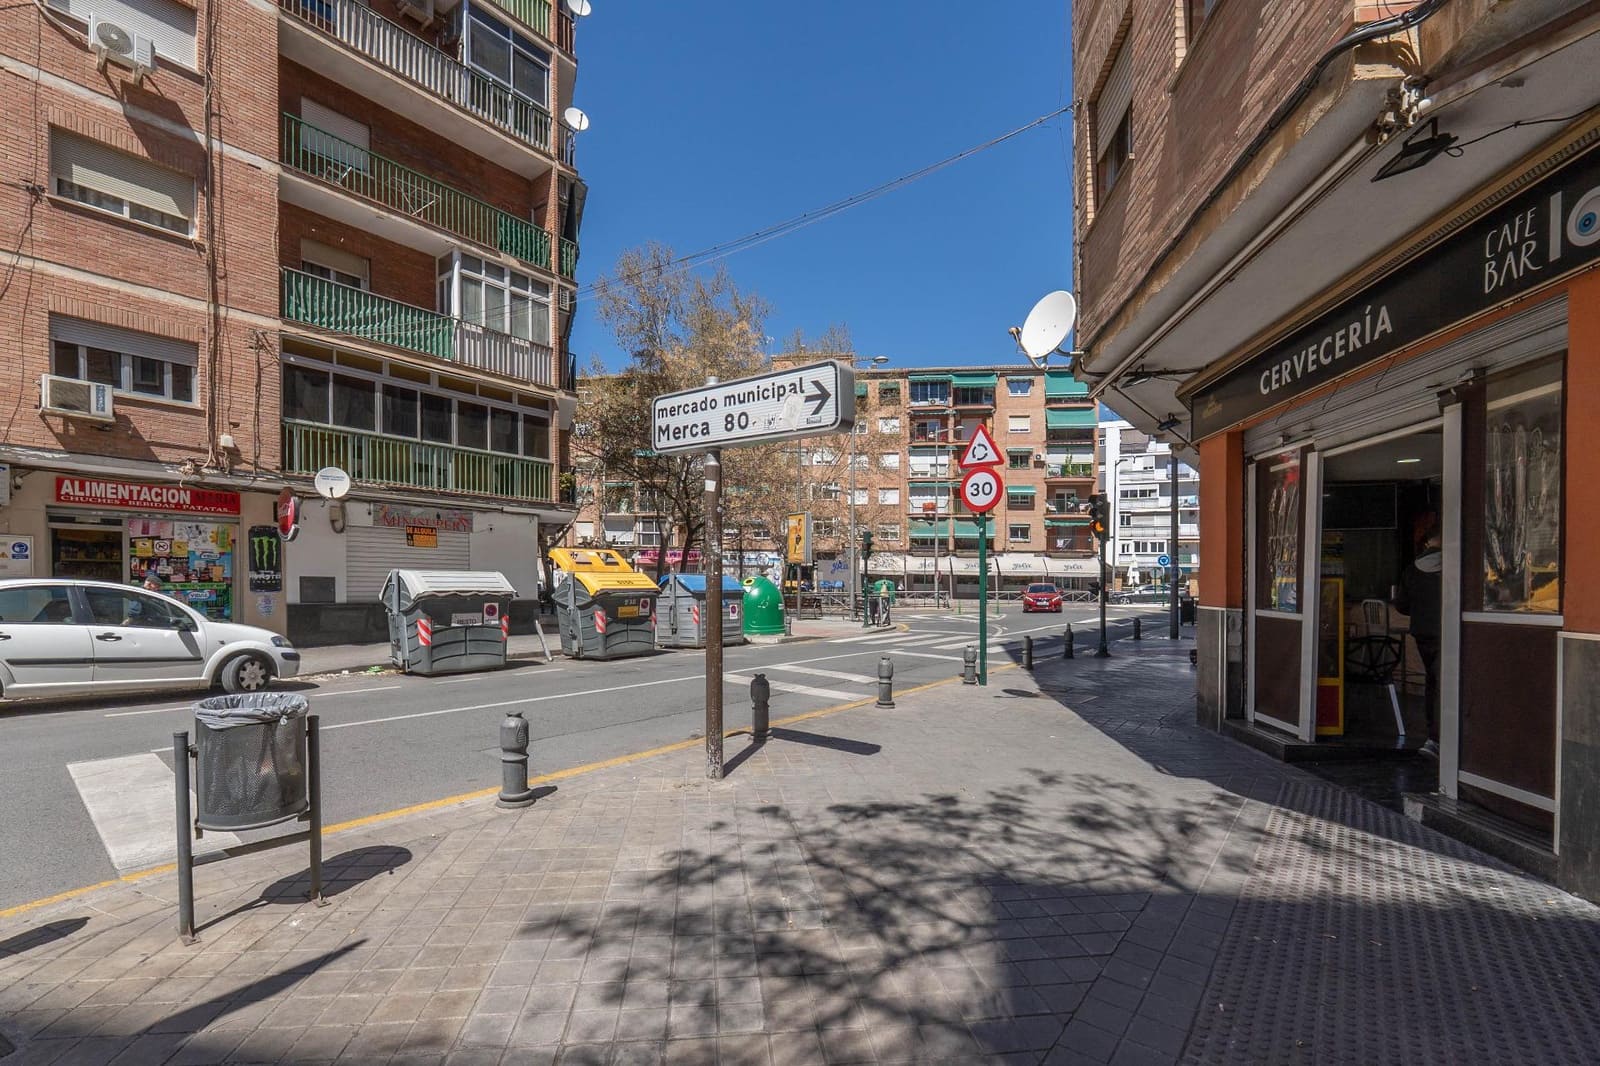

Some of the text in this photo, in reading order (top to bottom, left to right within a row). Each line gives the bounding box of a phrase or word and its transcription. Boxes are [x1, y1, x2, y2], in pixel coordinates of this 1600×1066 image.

[1485, 206, 1537, 258] CAFE
[1484, 240, 1543, 294] BAR
[1259, 304, 1393, 395] CERVECERÍA
[657, 376, 805, 419] mercado municipal
[657, 411, 749, 442] Merca 80
[60, 479, 191, 505] ALIMENTACION
[60, 495, 121, 505] CHUCHES
[128, 500, 175, 509] BEBIDAS
[970, 481, 993, 497] 30
